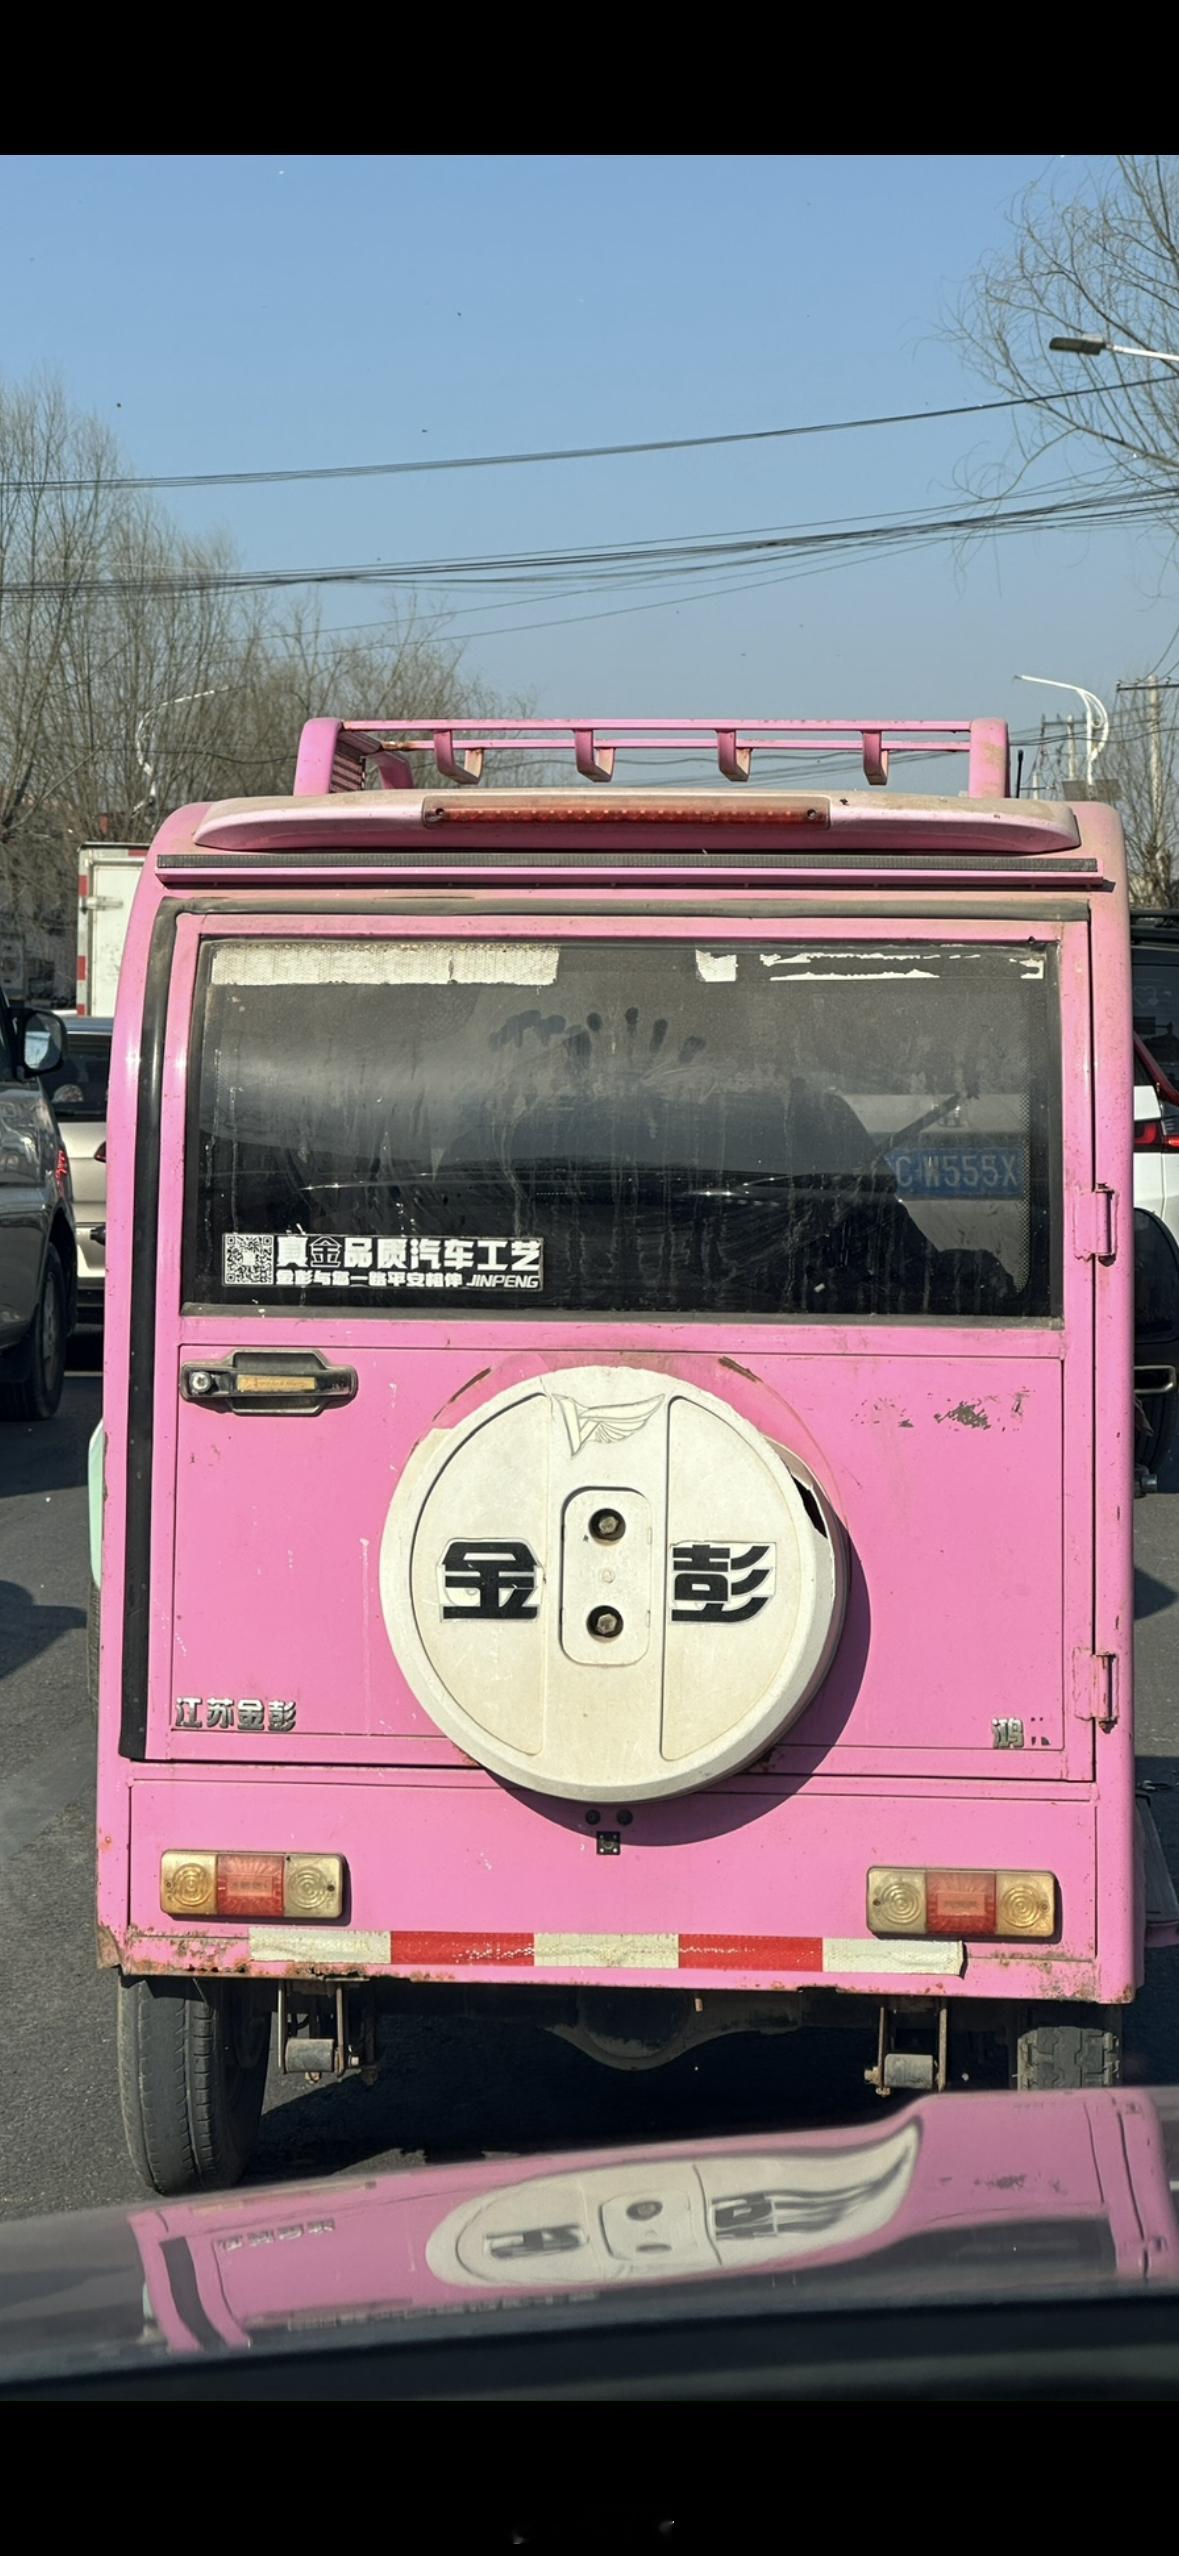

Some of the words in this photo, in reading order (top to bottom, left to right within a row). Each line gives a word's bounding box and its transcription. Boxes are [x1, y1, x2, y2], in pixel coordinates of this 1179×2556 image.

[276, 1235, 541, 1271] 真金品质汽车工艺
[466, 1275, 539, 1289] JINPENG
[175, 1697, 297, 1732] 江苏金彭
